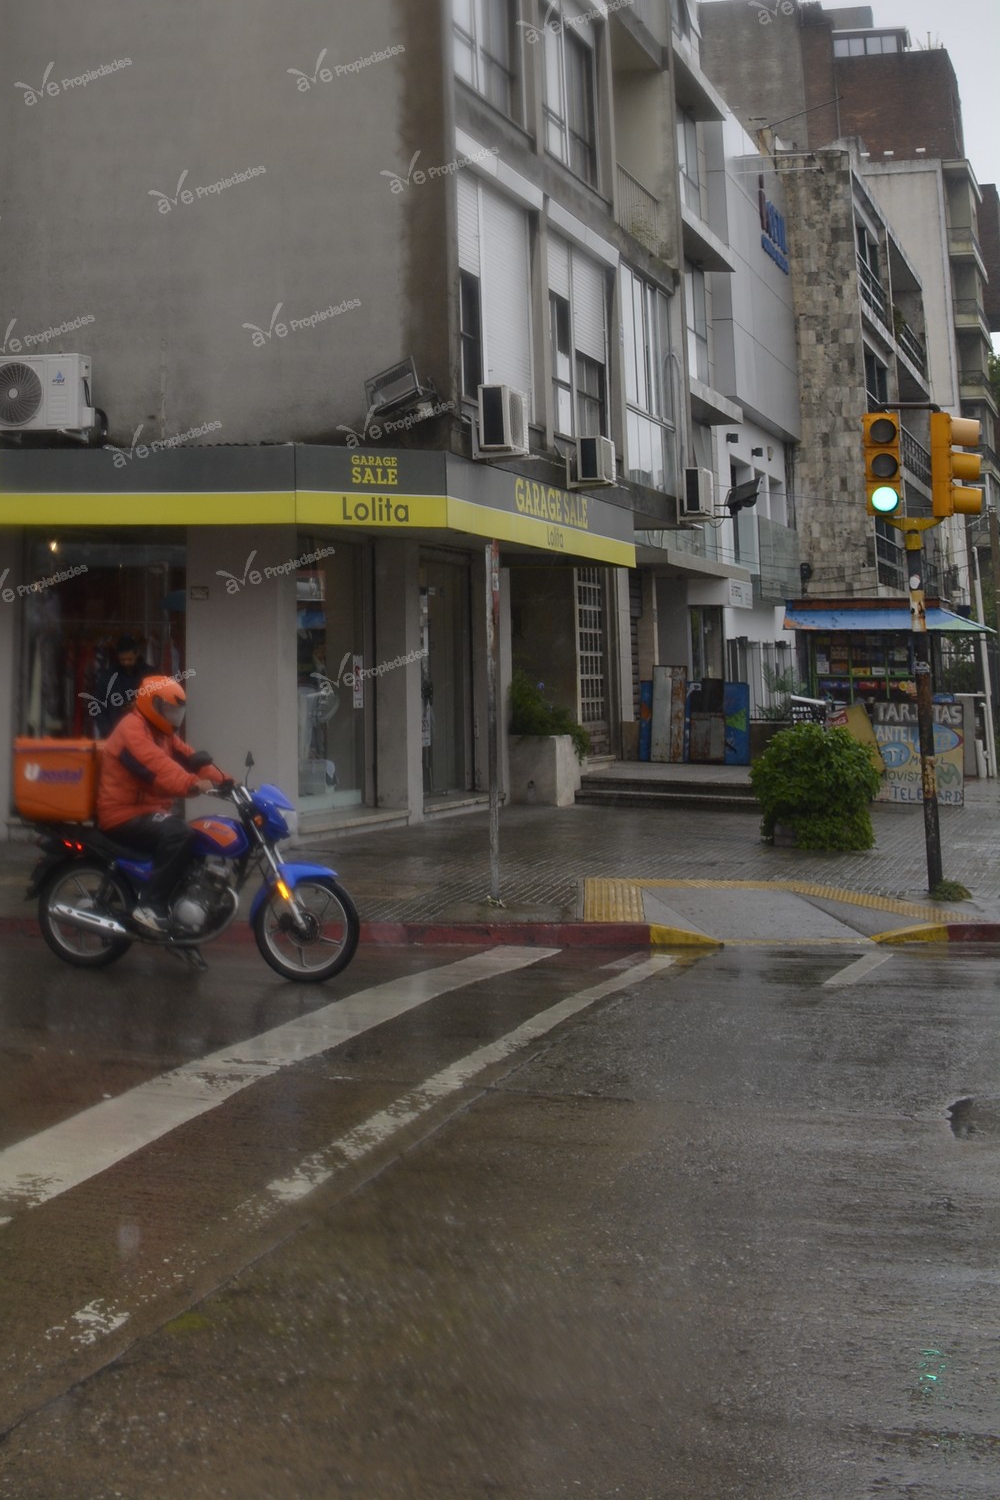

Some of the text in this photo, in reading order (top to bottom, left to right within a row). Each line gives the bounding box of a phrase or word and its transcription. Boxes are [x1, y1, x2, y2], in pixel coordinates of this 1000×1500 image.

[351, 454, 398, 467] GARAGE
[351, 466, 398, 485] SALE
[342, 496, 409, 523] Lolita
[515, 477, 589, 530] GARAGE SALE
[877, 702, 962, 725] TARJTAS
[875, 726, 913, 742] ANTEL
[891, 785, 962, 803] TELEARD
